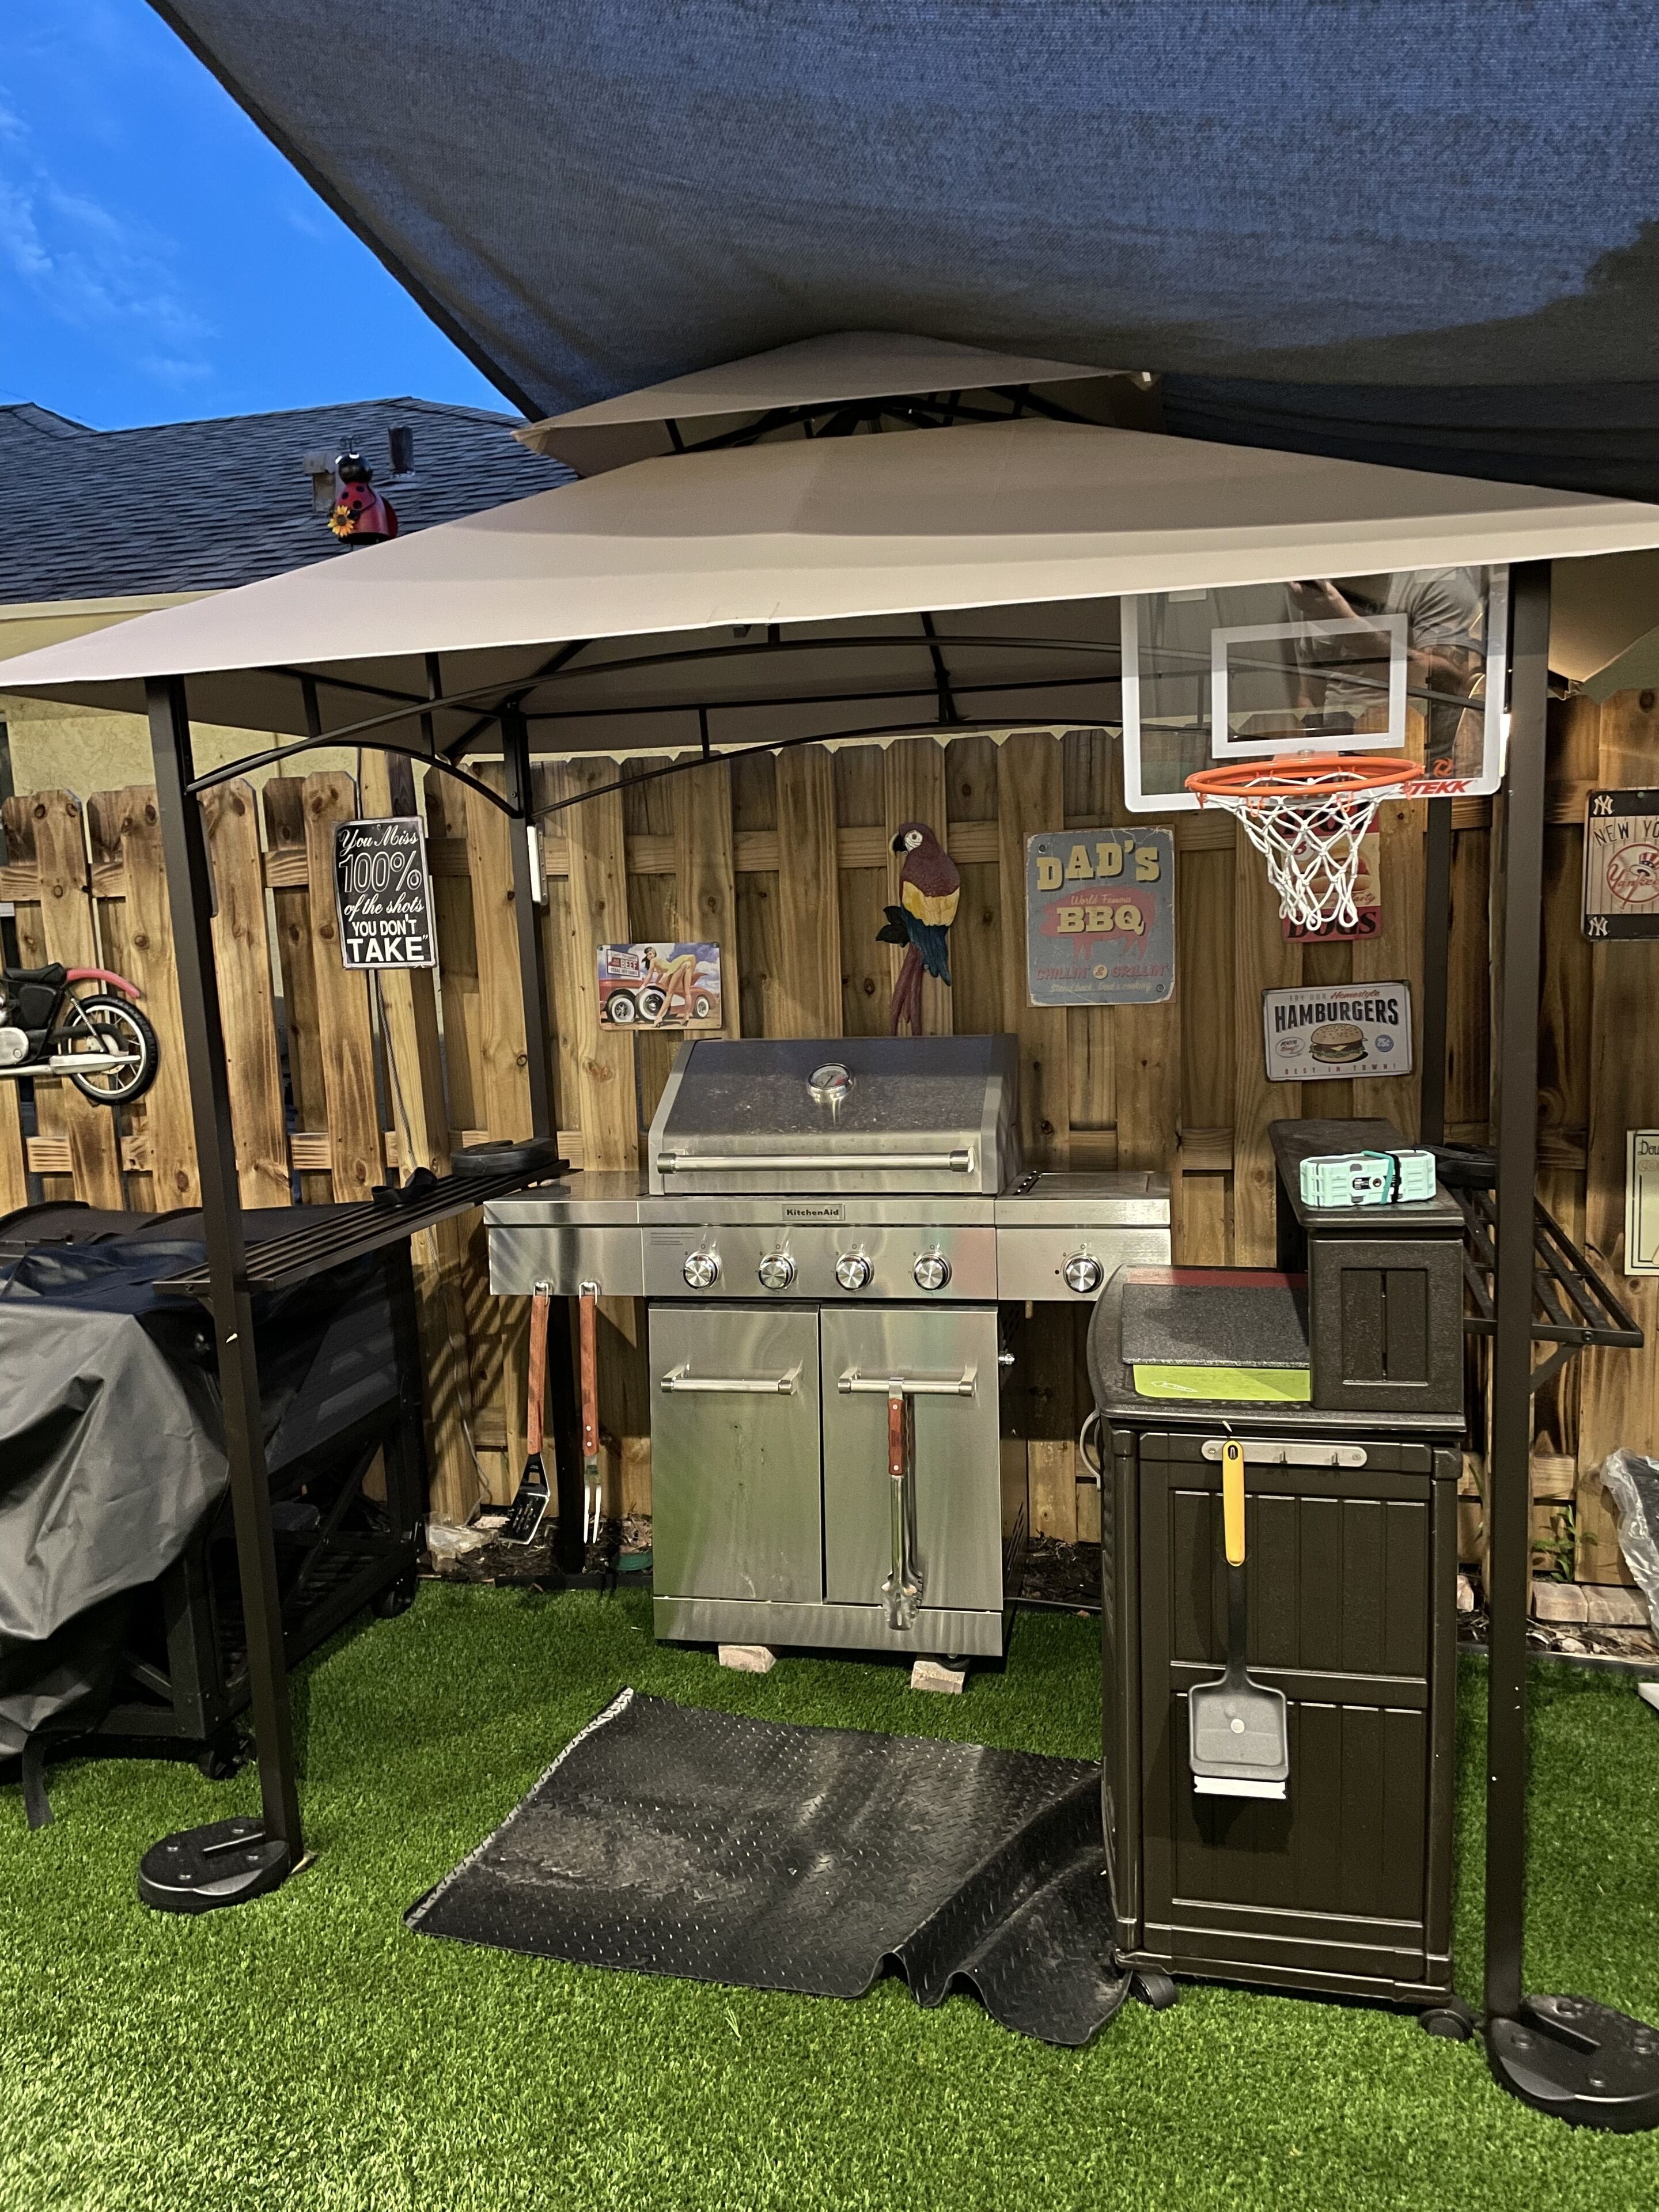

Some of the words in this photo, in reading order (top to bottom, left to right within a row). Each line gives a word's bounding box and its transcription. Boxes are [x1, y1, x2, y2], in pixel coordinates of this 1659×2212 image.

[374, 824, 419, 847] Miss
[1594, 821, 1629, 847] NEW
[338, 850, 422, 893] 100%
[1037, 839, 1161, 892] DAD'S
[343, 893, 366, 922] of
[362, 893, 383, 915] the
[385, 891, 425, 914] shots
[1071, 894, 1099, 906] World
[1102, 893, 1132, 904] Famous
[352, 921, 379, 937] YOU
[380, 913, 417, 935] DON'T
[1056, 904, 1145, 936] BBQ
[620, 959, 637, 970] BEEF
[1036, 966, 1090, 980] CHILLIN'
[1111, 963, 1170, 979] GRILLIN'
[1309, 993, 1327, 1001] OUR
[1331, 989, 1380, 999] Homestyle
[1274, 998, 1400, 1033] HAMBURGERS
[1284, 1067, 1316, 1075] BEST
[1353, 1063, 1397, 1072] TOWN!
